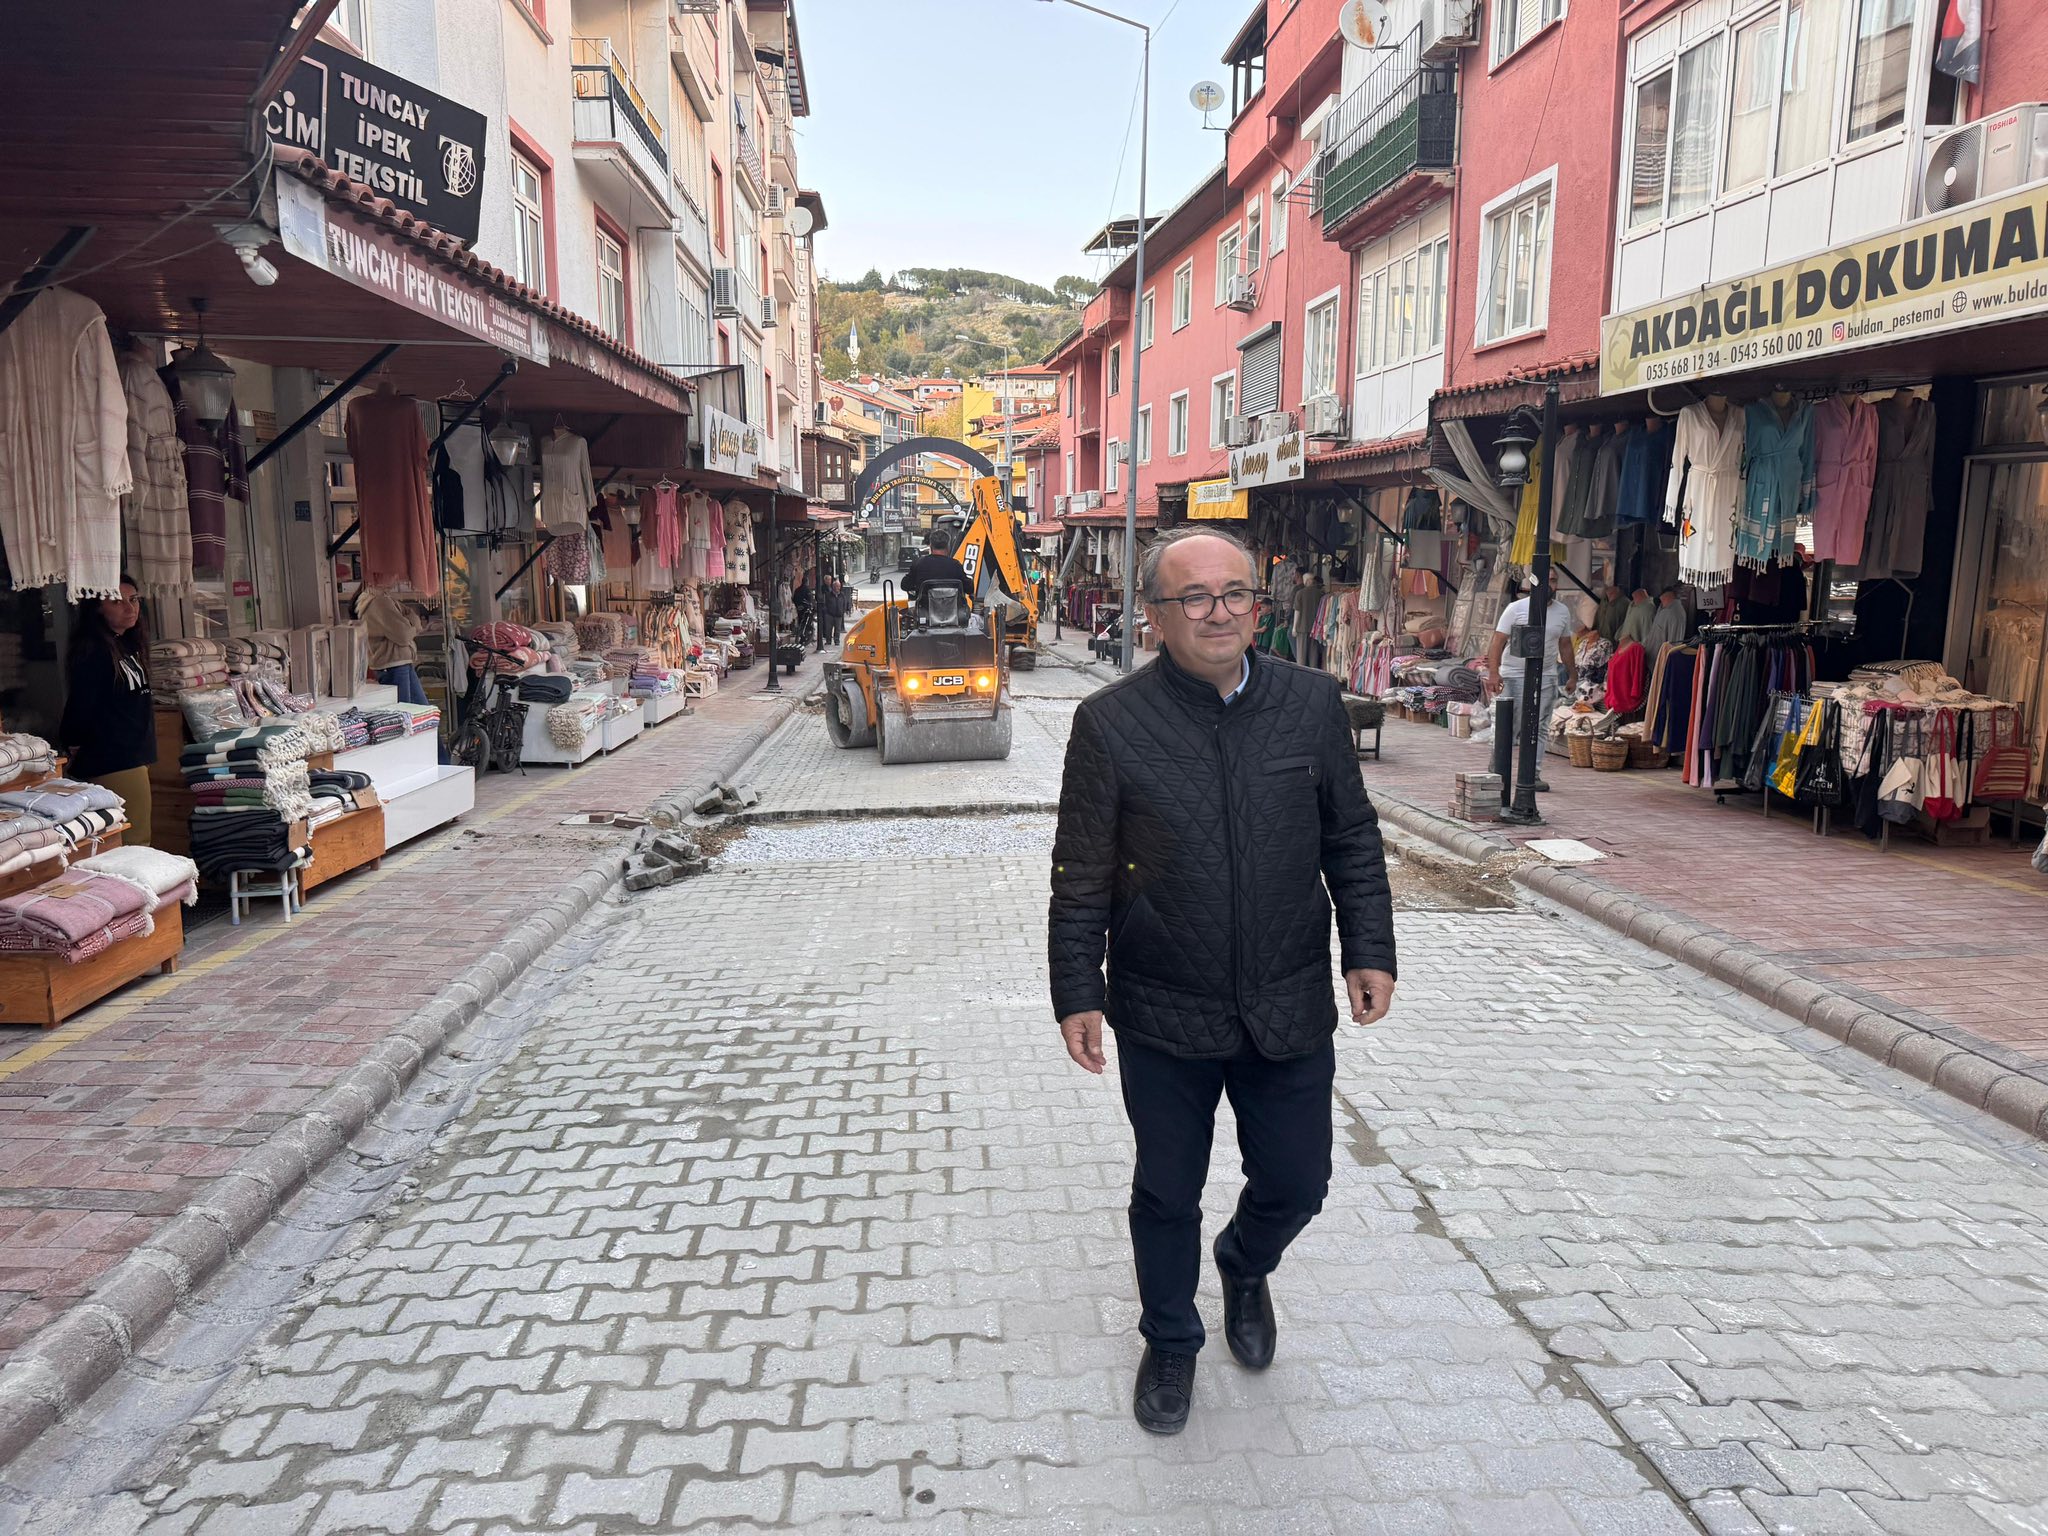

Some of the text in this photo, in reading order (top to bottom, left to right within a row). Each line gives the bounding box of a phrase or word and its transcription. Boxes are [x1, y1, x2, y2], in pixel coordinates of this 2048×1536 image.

[340, 71, 430, 131] TUNCAY
[1988, 116, 2018, 132] TOSHIBA
[357, 112, 412, 163] İPEK
[335, 148, 428, 206] TEKSTİL
[328, 222, 488, 333] TUNCAY İPEK TEKSTİL
[1629, 200, 2048, 359] AKDAĞLI DOKUMA
[1847, 301, 1945, 338] buldan_pestemal
[1646, 360, 1669, 381] 0535
[1671, 356, 1689, 376] 668
[1692, 354, 1704, 371] 12
[1707, 352, 1720, 369] 34
[1730, 342, 1758, 364] 0543
[1762, 336, 1783, 357] 560
[1787, 331, 1802, 350] 00
[1807, 327, 1823, 348] 20
[870, 482, 891, 504] BULDAN
[890, 475, 910, 486] TARİHİ
[911, 476, 937, 488] DOKUMA
[1703, 598, 1714, 607] 350
[933, 676, 964, 686] JCB
